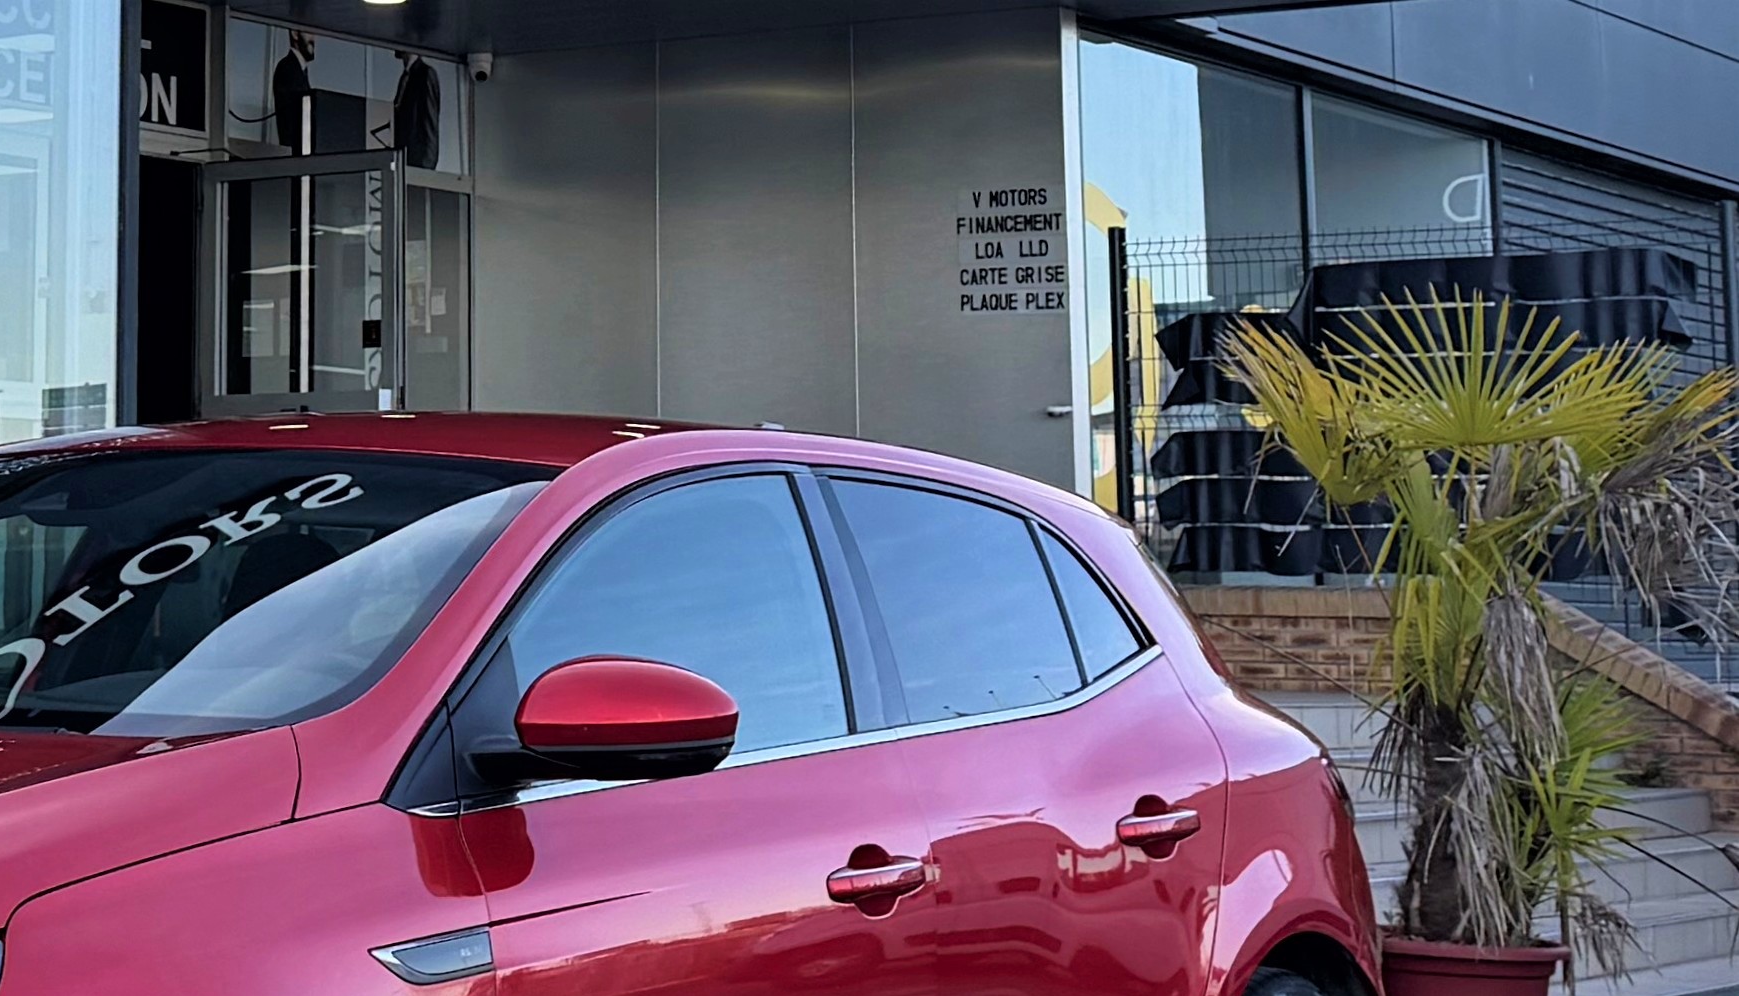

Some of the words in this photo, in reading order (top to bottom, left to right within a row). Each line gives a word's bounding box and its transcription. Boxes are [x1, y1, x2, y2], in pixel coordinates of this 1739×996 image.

[972, 191, 981, 208] V
[989, 188, 1047, 208] MOTORS
[956, 213, 1062, 234] FINANCEMENT
[975, 241, 1004, 259] LOA
[1019, 239, 1049, 257] LLD
[960, 267, 1008, 285] CARTE
[1015, 265, 1065, 283] GRISE
[960, 293, 1018, 311] PLAQUE
[1025, 292, 1065, 309] PLEX
